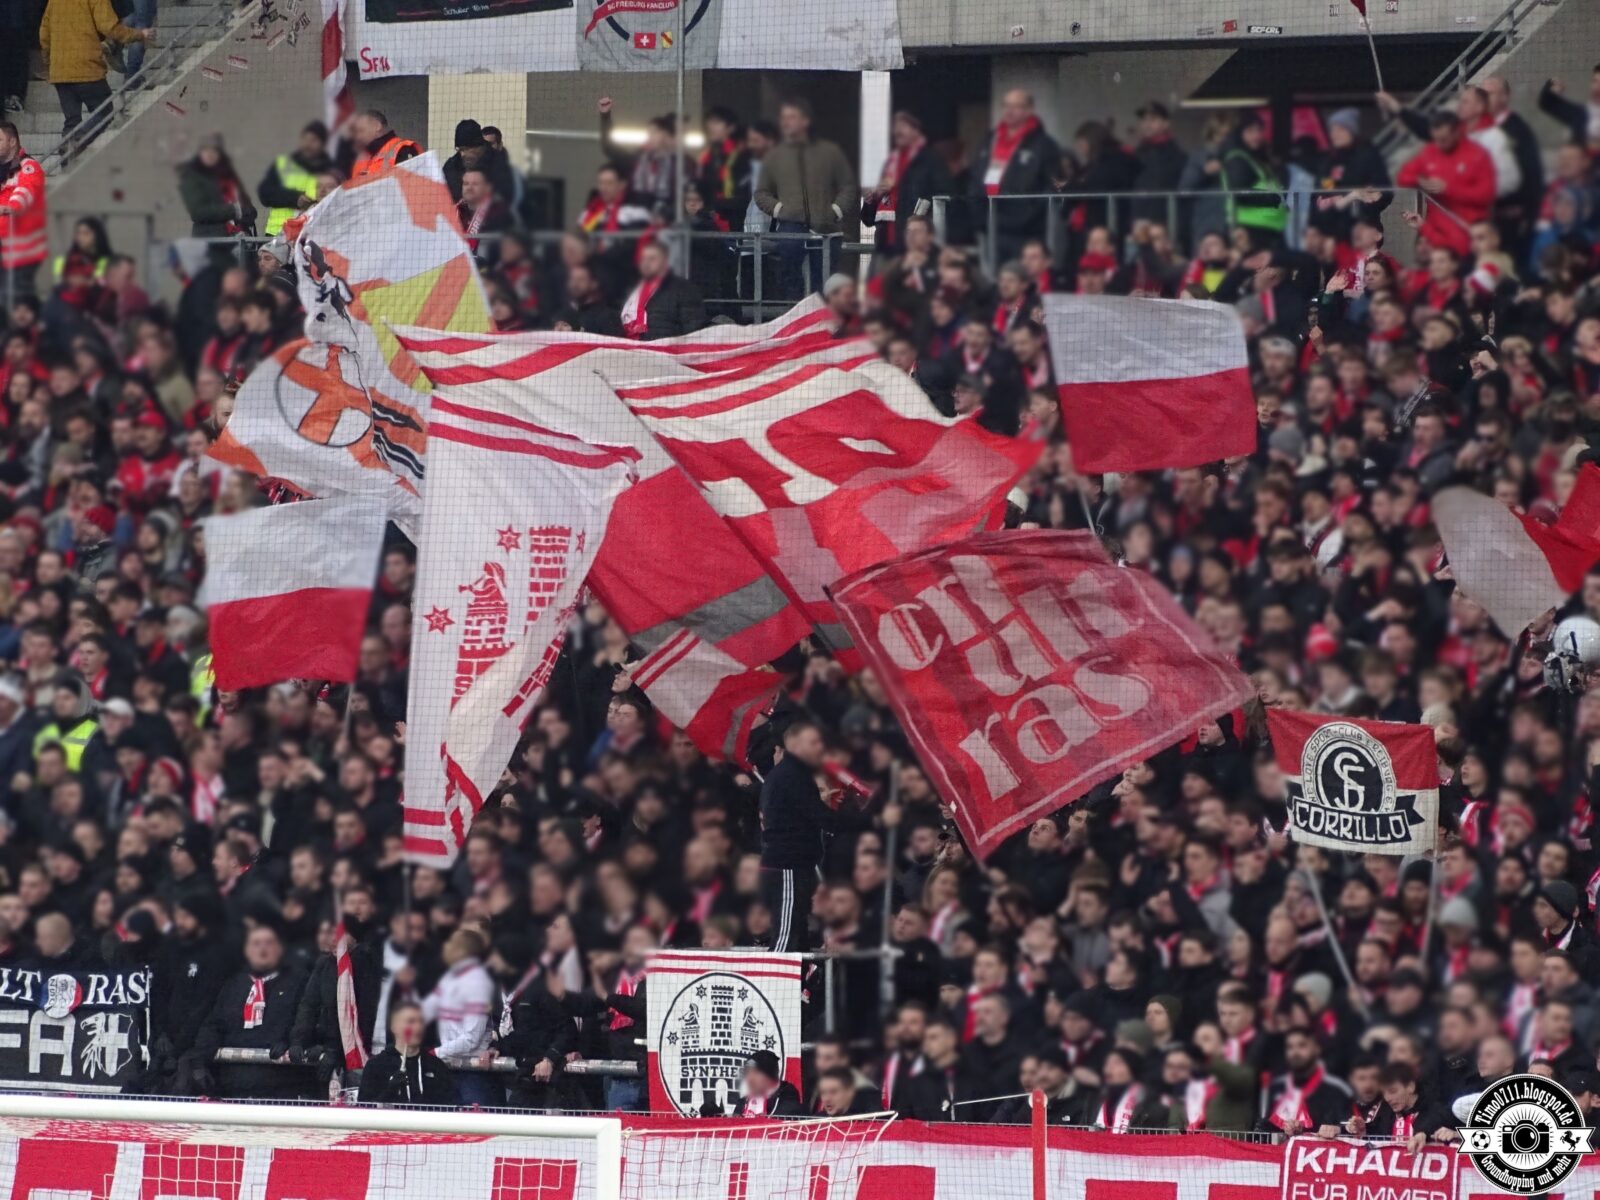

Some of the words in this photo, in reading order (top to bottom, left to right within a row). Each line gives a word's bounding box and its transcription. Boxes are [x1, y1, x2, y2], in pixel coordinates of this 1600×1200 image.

[957, 655, 1154, 801] ras
[1306, 754, 1315, 784] LOVE
[1295, 801, 1406, 841] CORRILLO
[681, 1065, 739, 1079] SYNTHE
[1295, 1147, 1449, 1181] KHALID
[1292, 1178, 1348, 1200] FÜR
